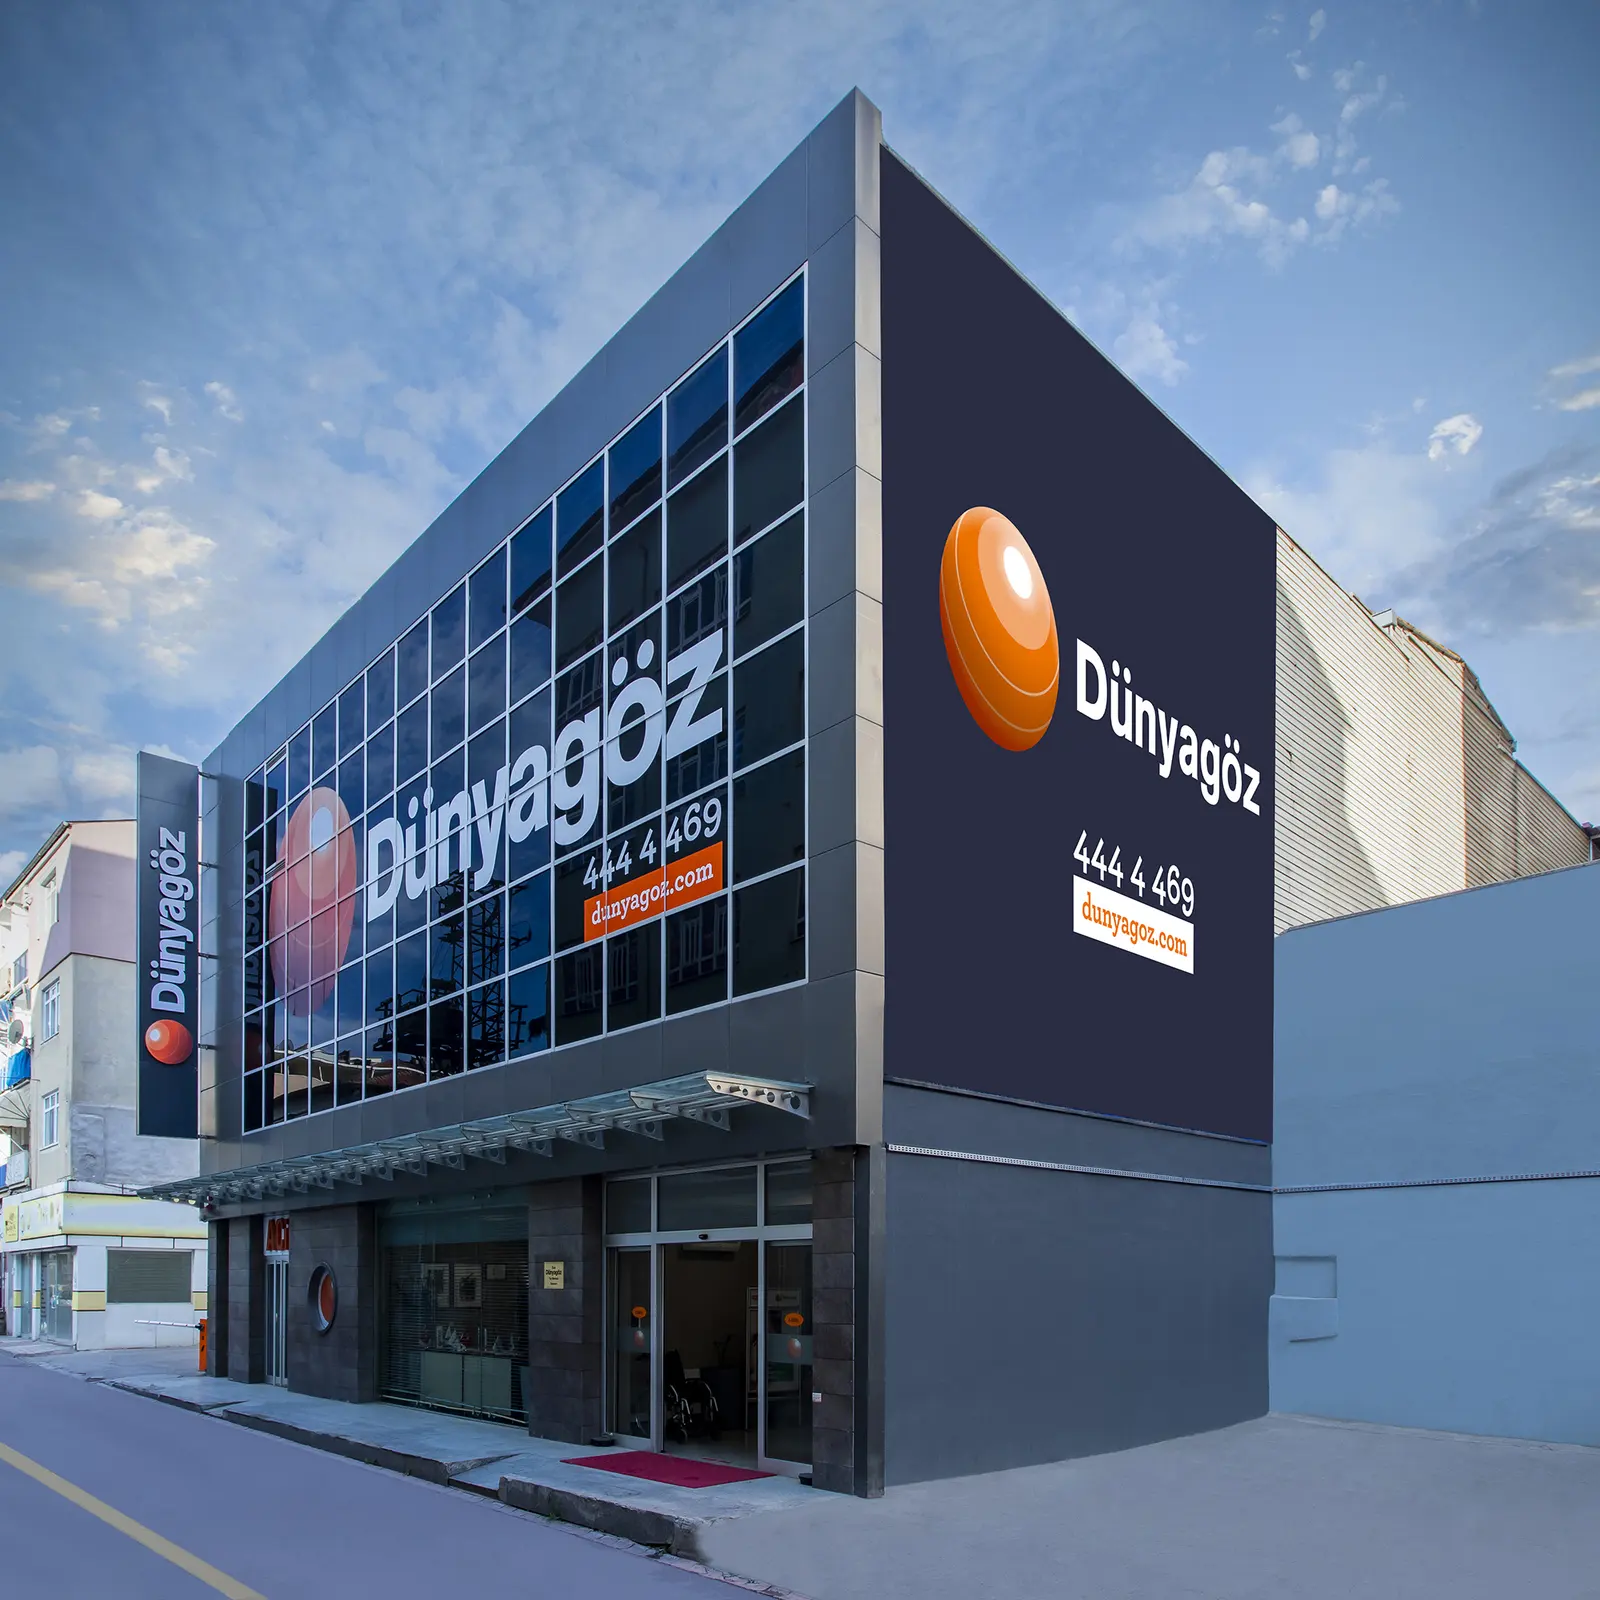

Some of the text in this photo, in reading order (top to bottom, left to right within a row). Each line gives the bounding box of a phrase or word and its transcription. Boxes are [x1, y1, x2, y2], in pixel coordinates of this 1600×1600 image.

[1076, 637, 1260, 816] Dünyagöz
[367, 628, 724, 922] Dünyagöz
[583, 798, 722, 890] 444 4 469
[1073, 829, 1195, 917] 444 4 469
[150, 826, 194, 1013] Dünyagöz
[591, 862, 714, 925] dunyagoz.com
[1081, 891, 1188, 957] dunyagoz.com
